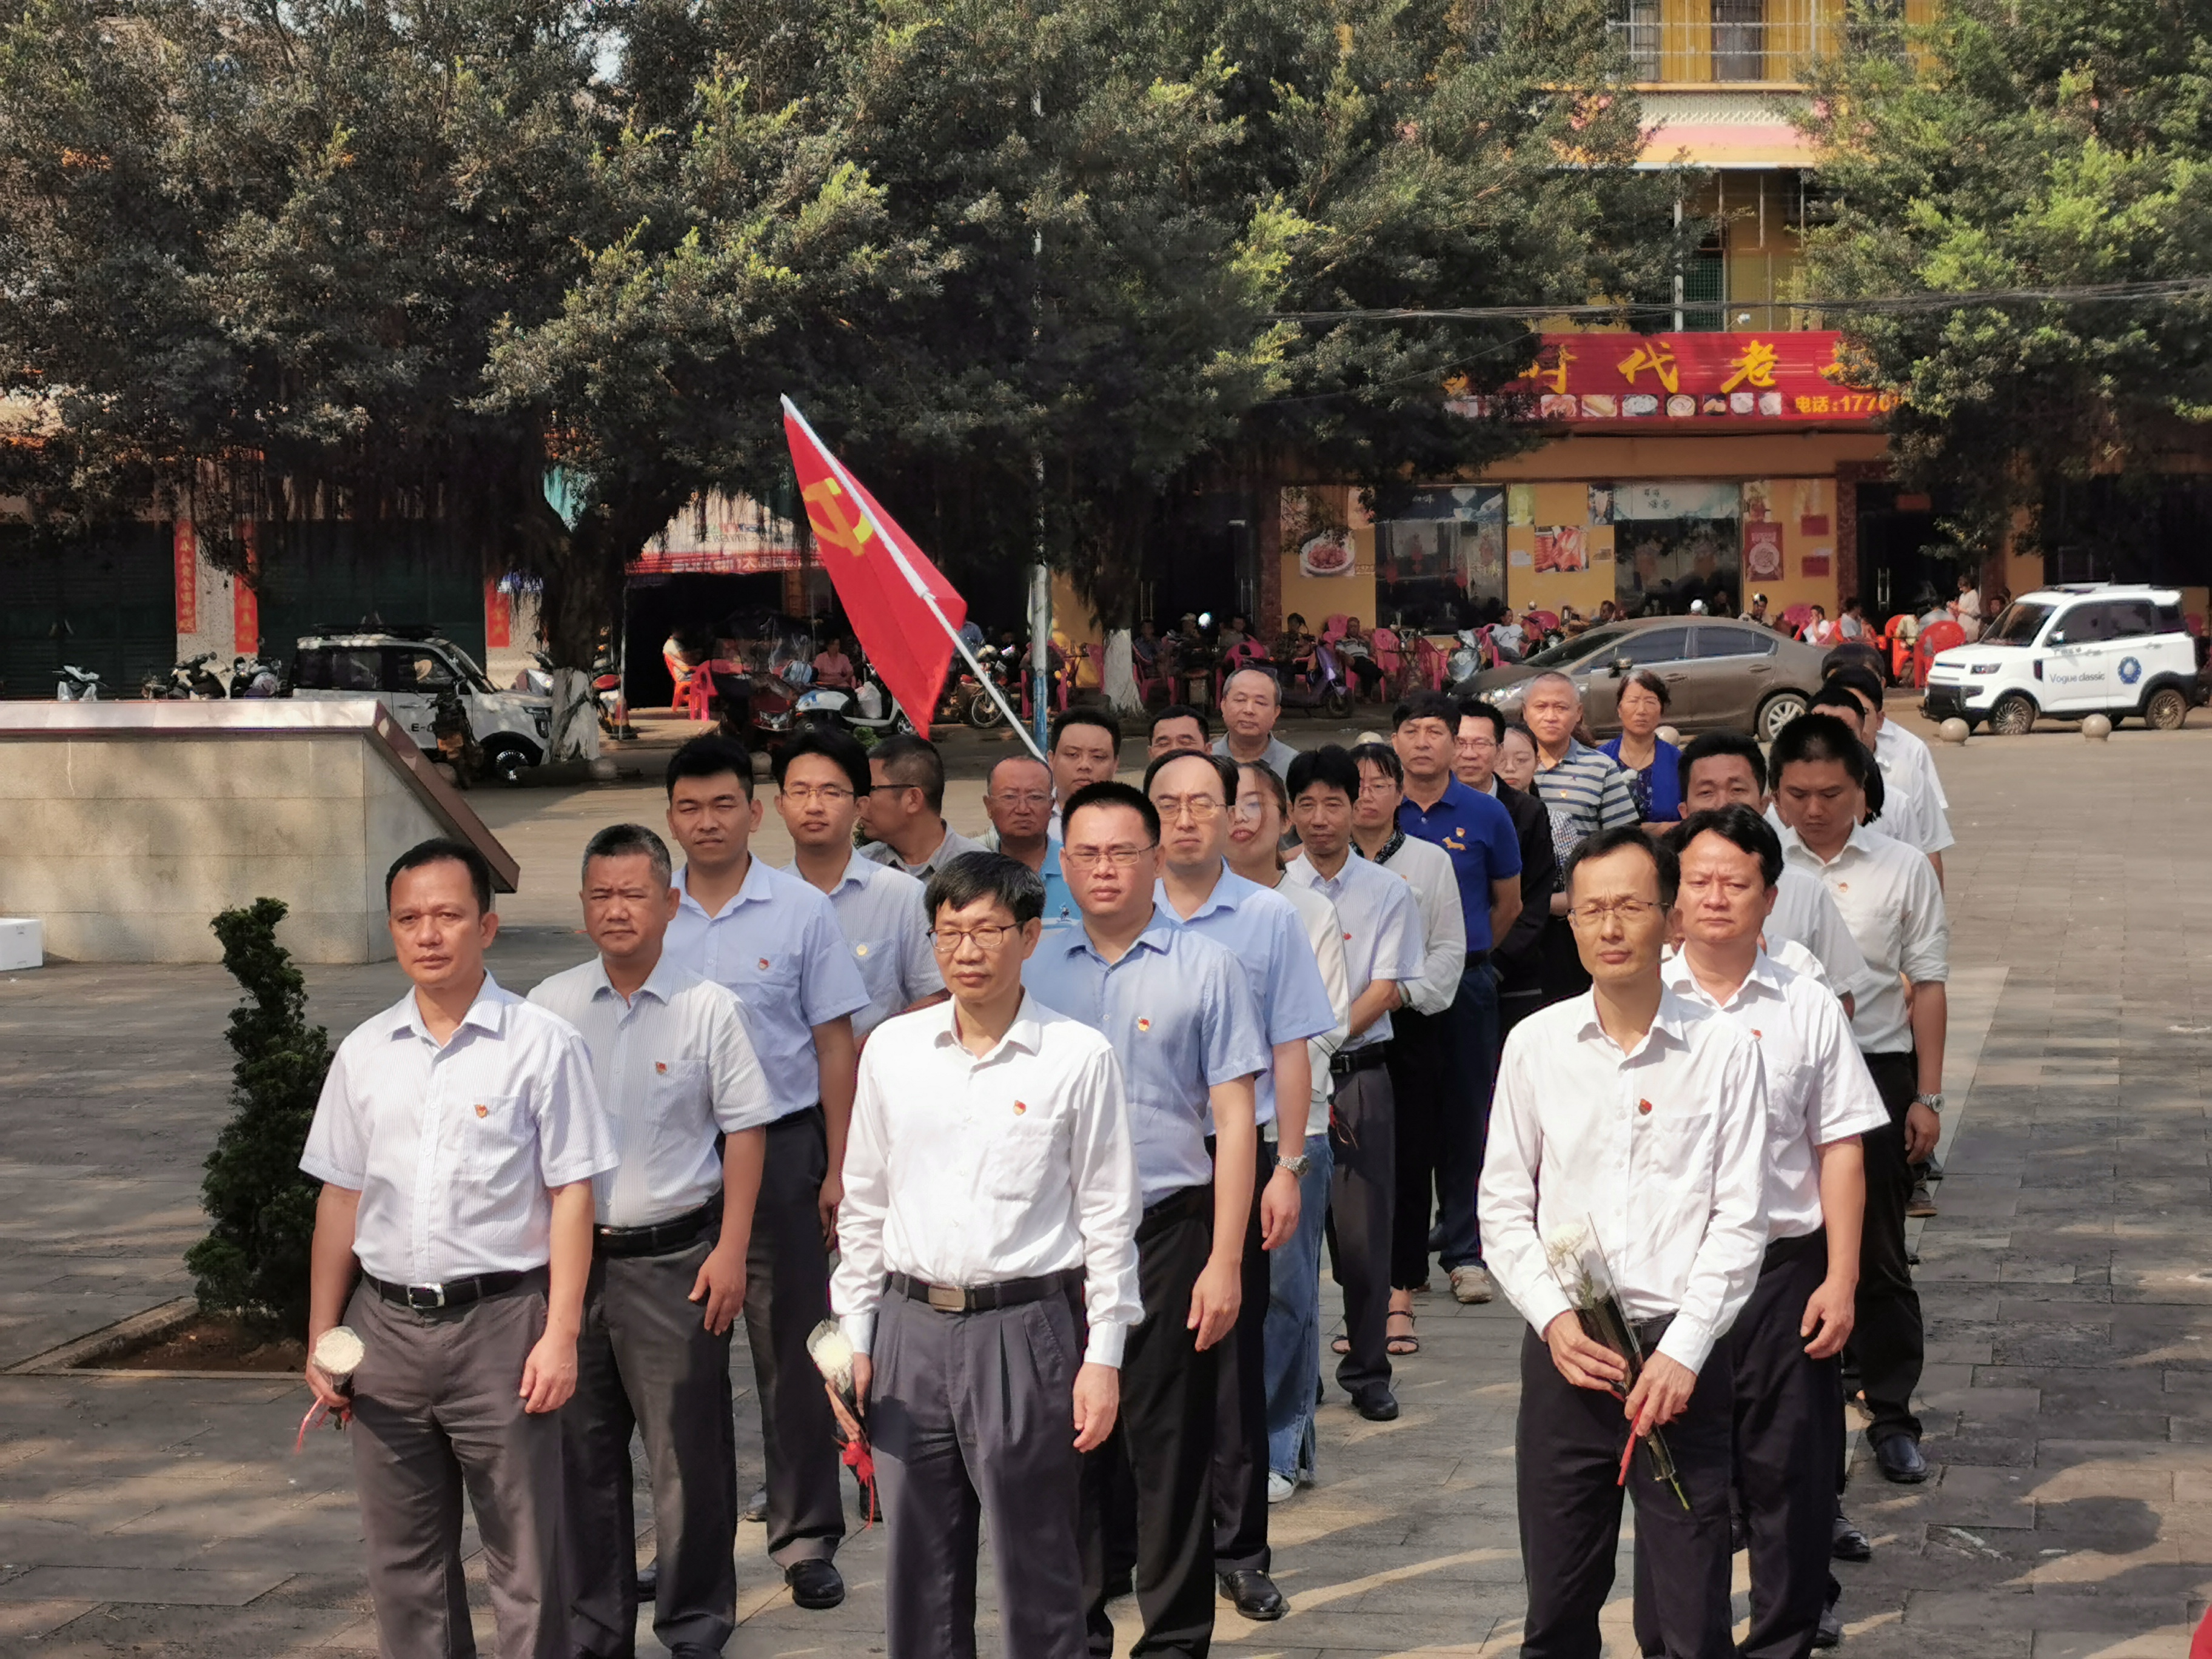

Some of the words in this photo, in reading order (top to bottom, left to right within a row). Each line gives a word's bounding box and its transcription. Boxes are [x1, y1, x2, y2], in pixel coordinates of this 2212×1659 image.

[1443, 340, 1877, 394] 时代老
[2049, 674, 2077, 685] Vogue
[2079, 671, 2105, 682] classic
